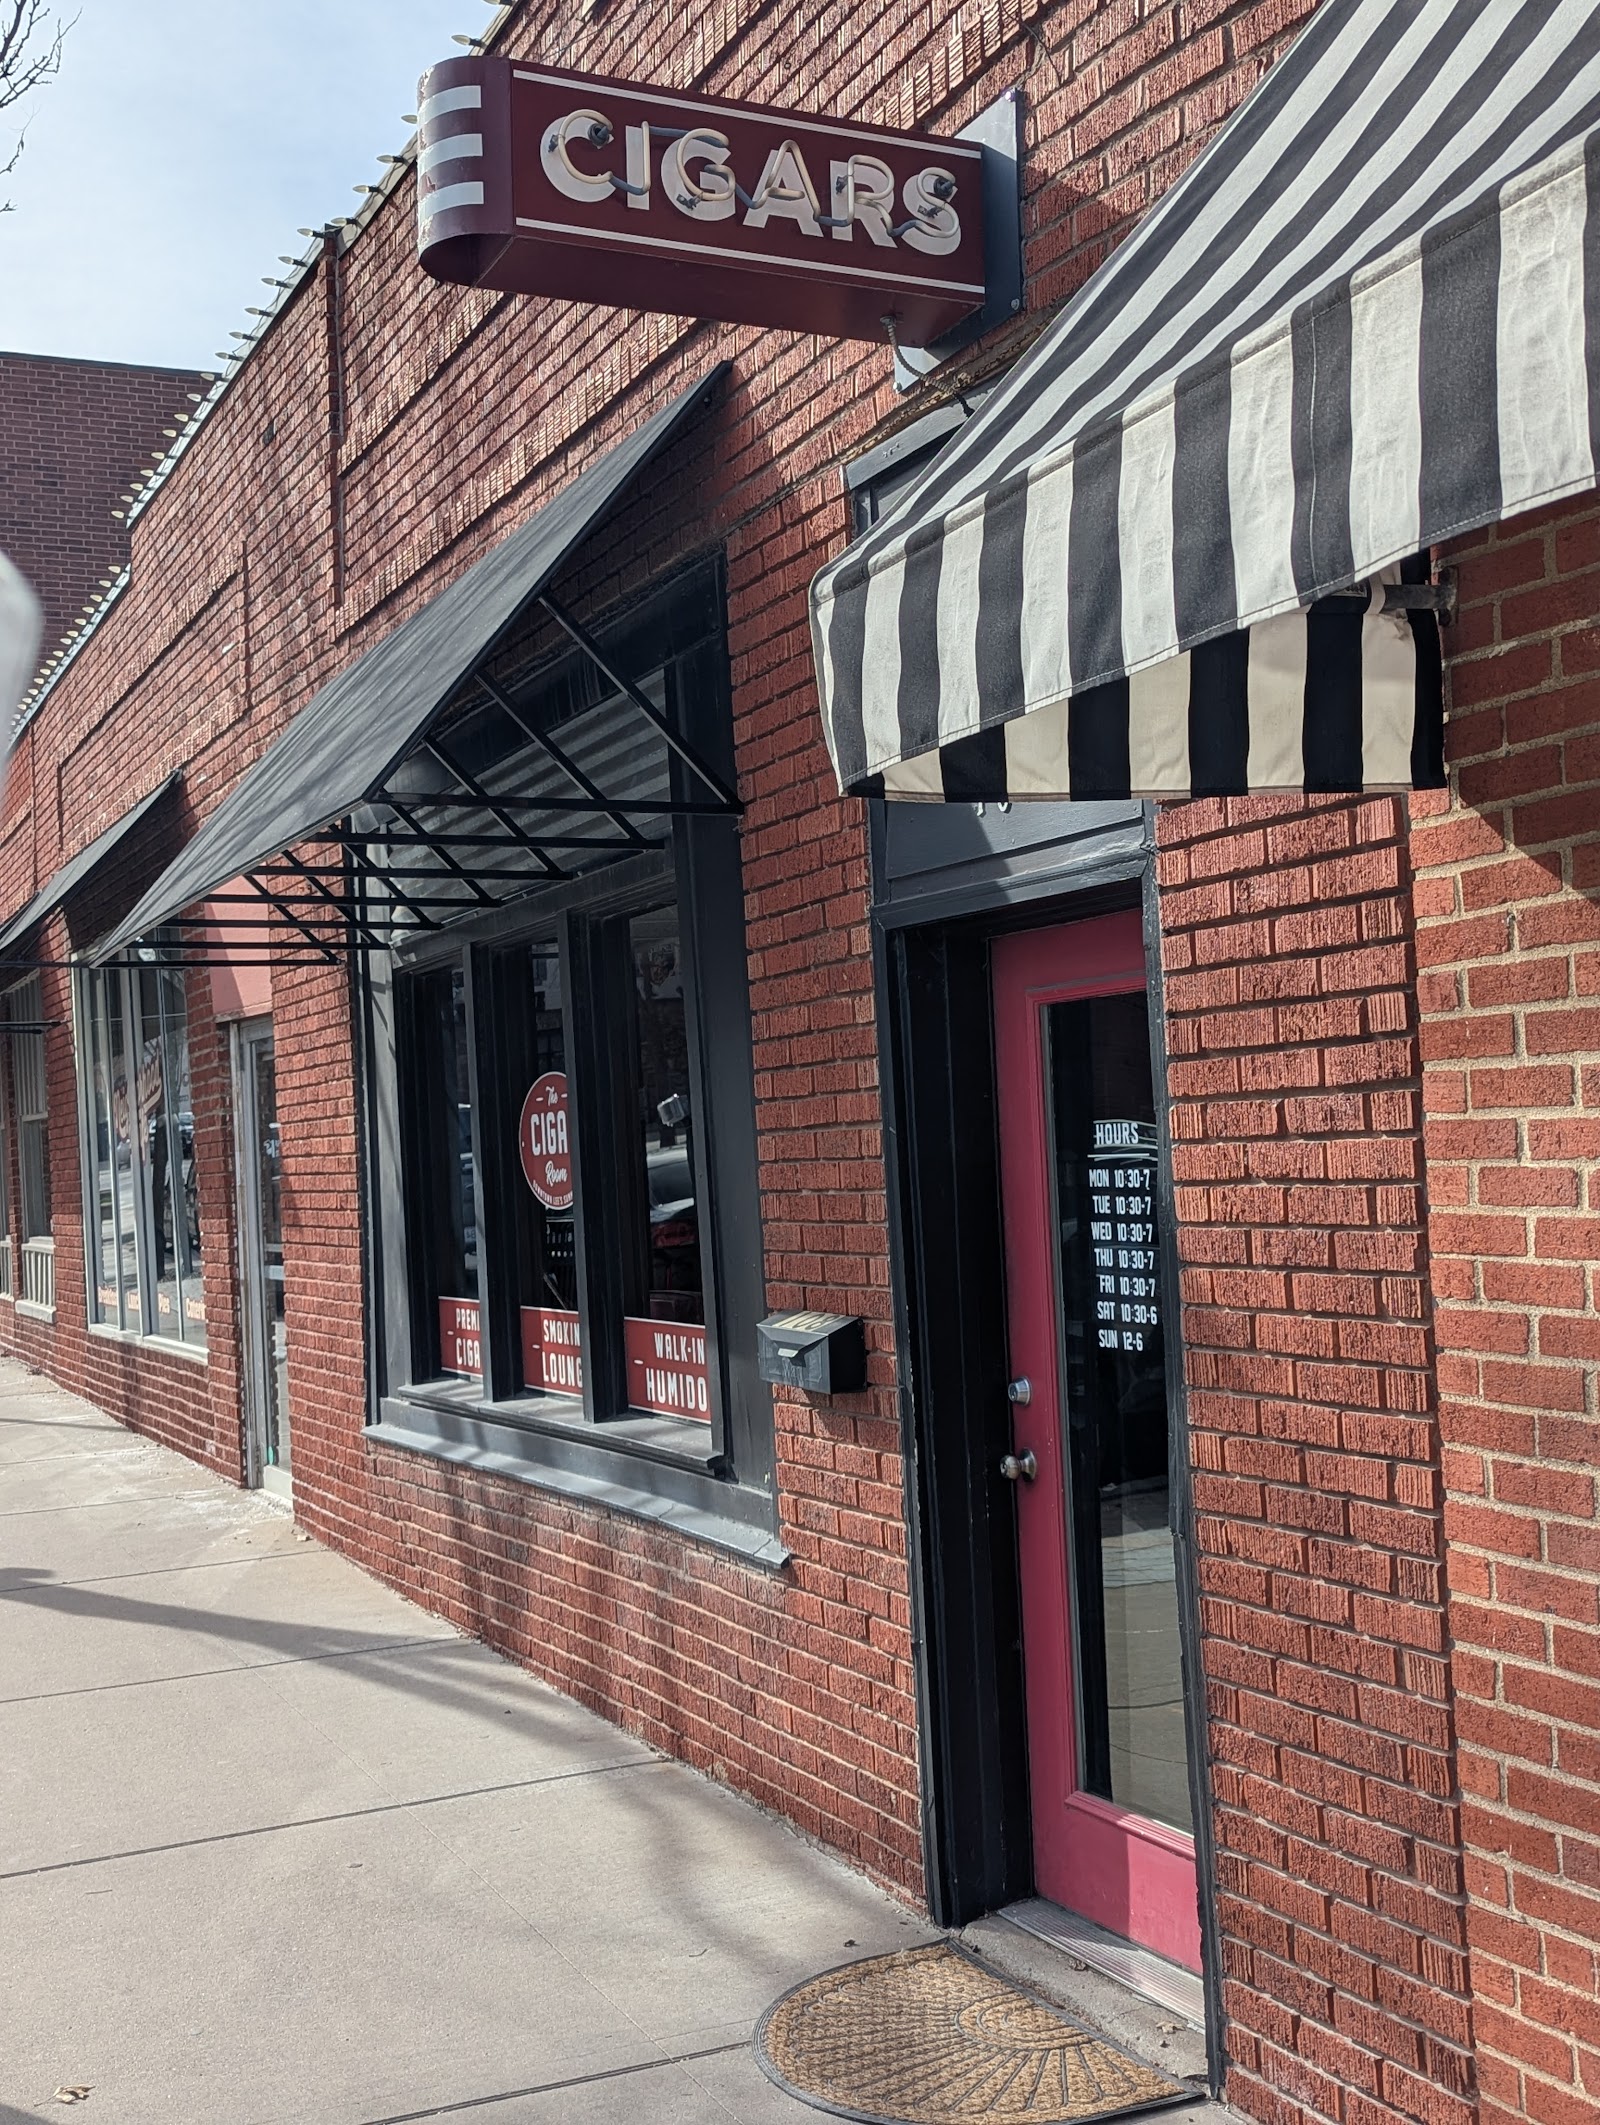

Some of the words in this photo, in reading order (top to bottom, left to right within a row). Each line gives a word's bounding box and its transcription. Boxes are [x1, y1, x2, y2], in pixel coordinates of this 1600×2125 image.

[540, 108, 962, 256] CIGARS
[530, 1110, 568, 1156] CIGA
[1095, 1122, 1139, 1145] HOURS
[545, 1160, 568, 1187] Room
[1089, 1169, 1110, 1188] MON
[1114, 1169, 1150, 1189] 10:30-7
[1092, 1195, 1111, 1214] TUE
[1115, 1196, 1151, 1215] 10:30-7
[1091, 1222, 1112, 1241] WED
[1117, 1222, 1153, 1242] 10:30-7
[1094, 1248, 1114, 1267] THU
[1118, 1249, 1154, 1270] 10:30-7
[1098, 1274, 1115, 1294] FRI
[1119, 1276, 1156, 1298] 10:30-7
[455, 1307, 480, 1332] PREMI
[1097, 1301, 1116, 1320] SAT
[1120, 1303, 1157, 1325] 10:30-6
[543, 1319, 581, 1347] SMOKIN
[1098, 1329, 1118, 1349] SUN
[1122, 1331, 1143, 1352] 12-6
[455, 1337, 481, 1369] CIGA
[654, 1332, 705, 1365] WALK-IN
[541, 1351, 583, 1388] LOUNG
[646, 1367, 707, 1412] HUMIDO
